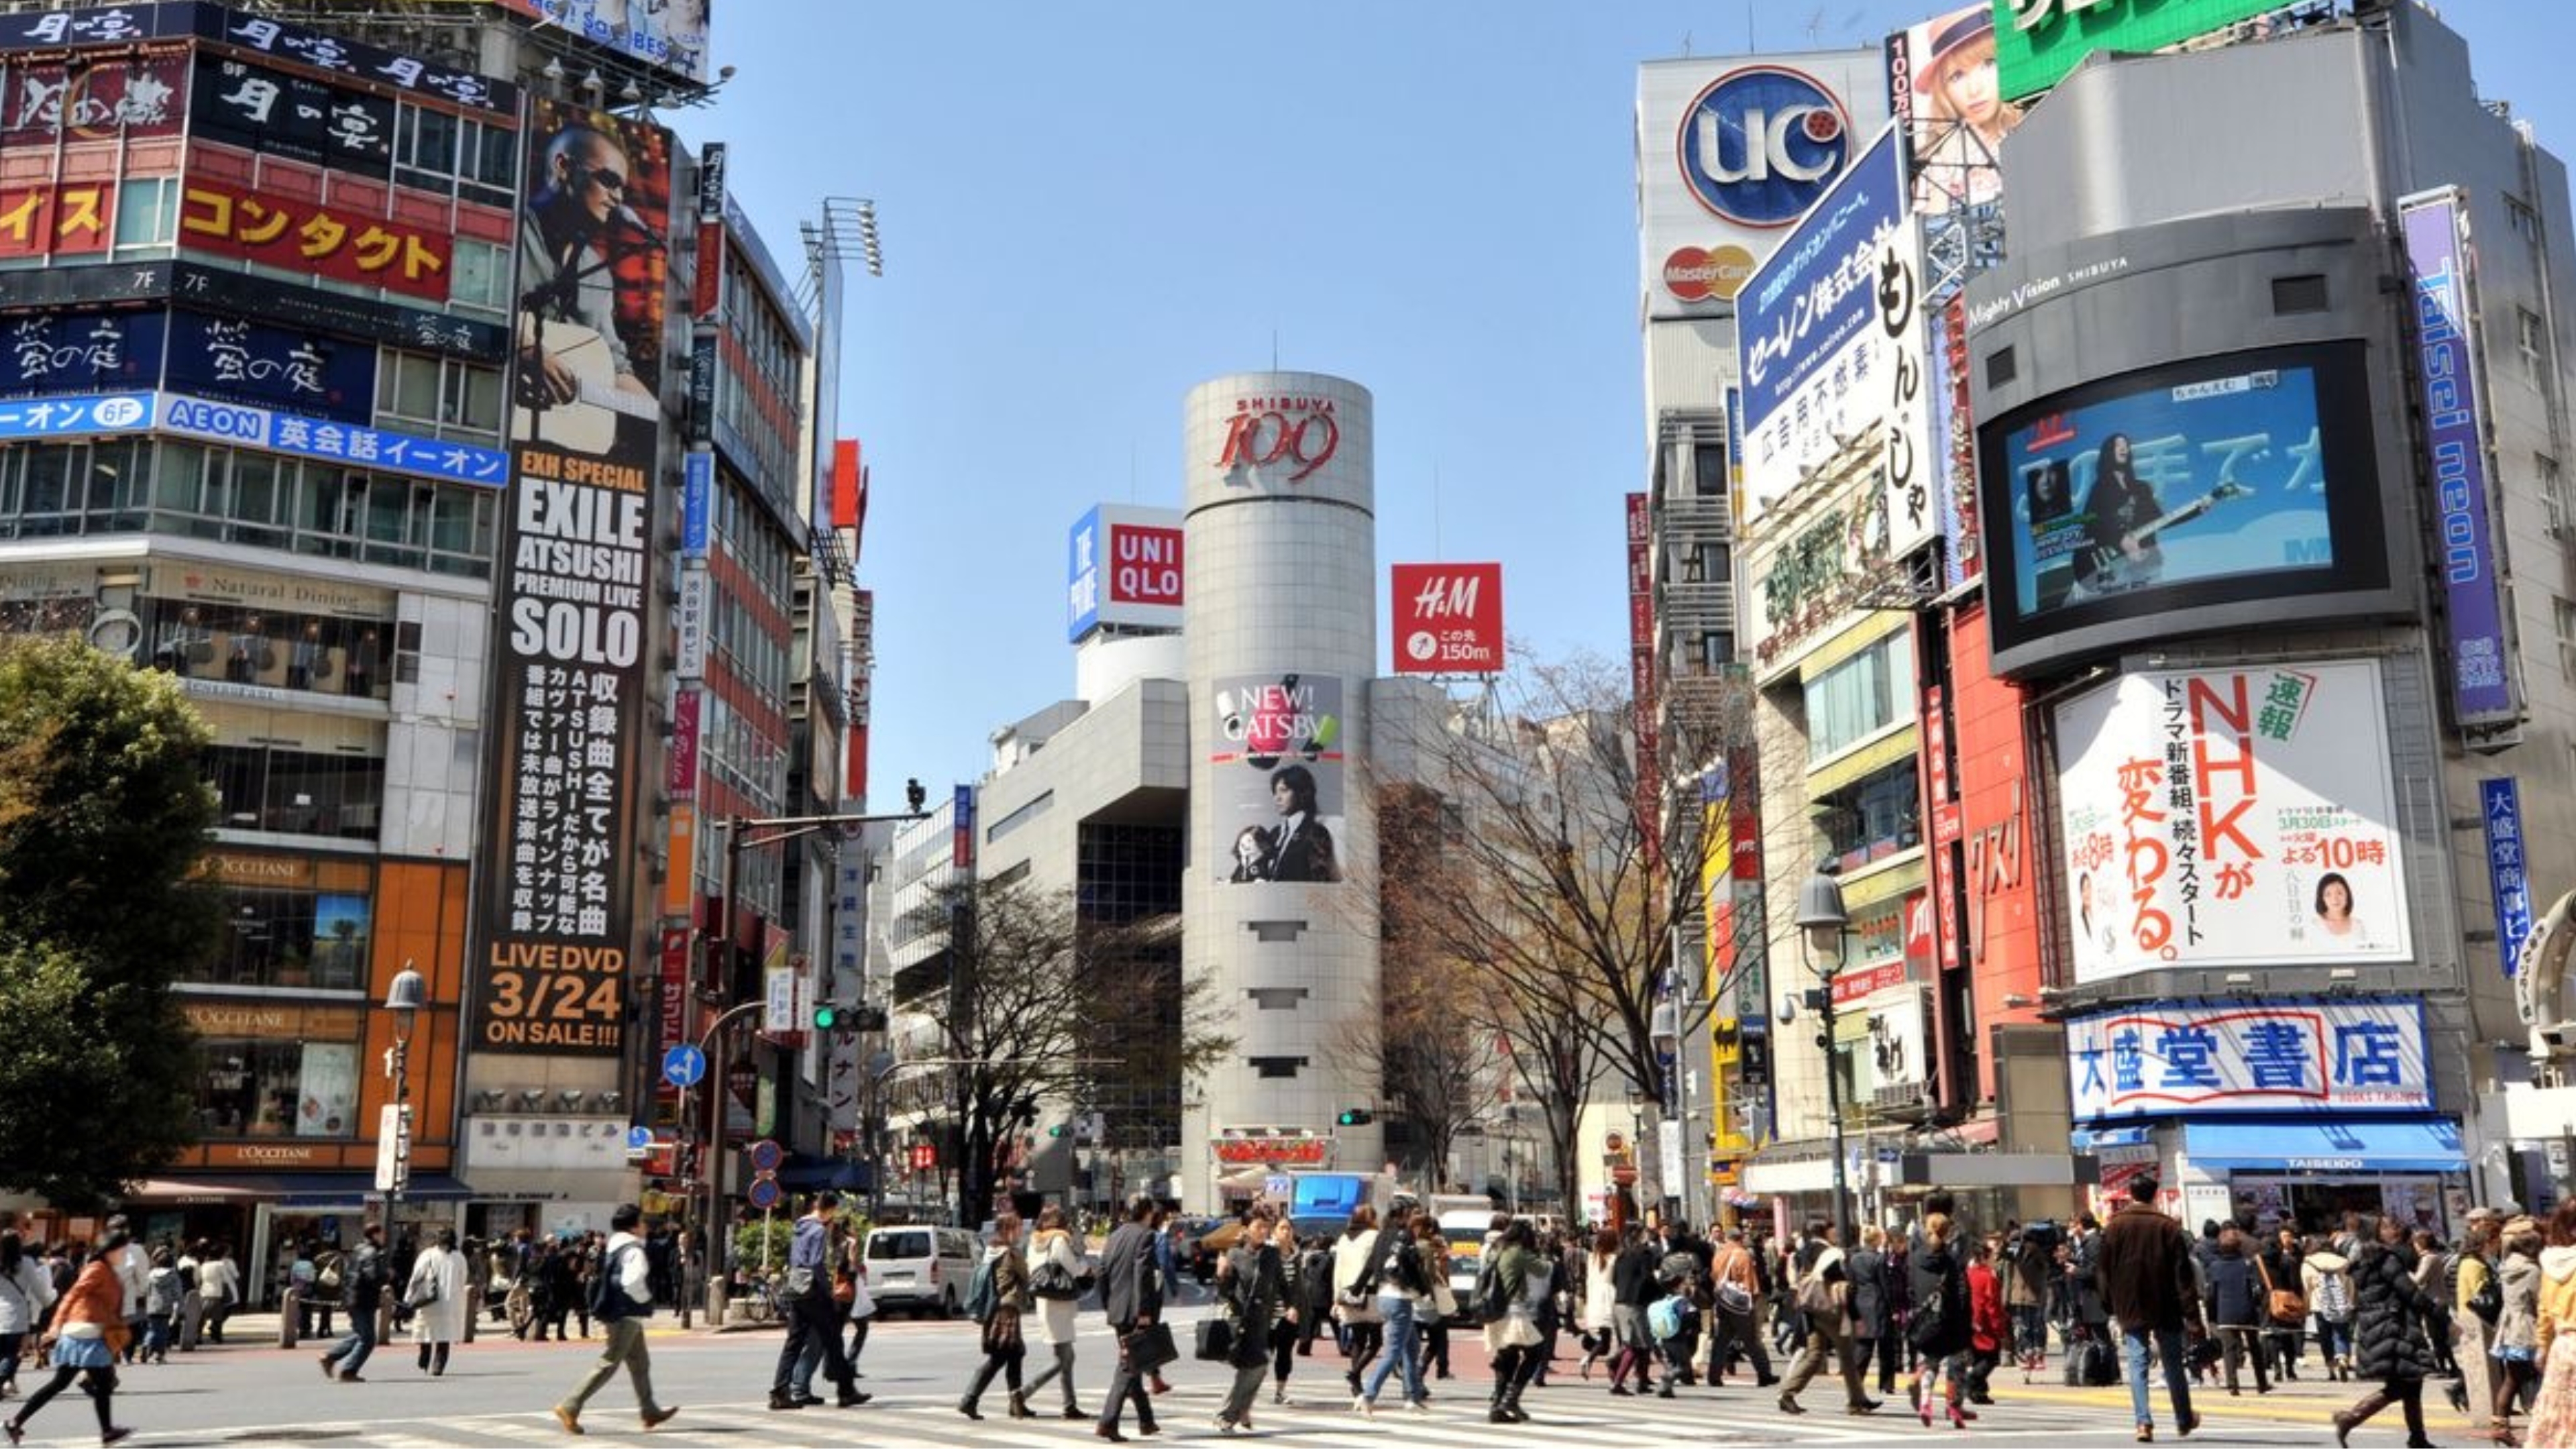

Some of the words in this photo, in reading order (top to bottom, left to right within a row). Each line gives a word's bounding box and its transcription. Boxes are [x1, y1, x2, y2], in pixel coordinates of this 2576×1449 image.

[184, 189, 441, 280] コンタクト
[134, 272, 157, 289] 7F
[185, 274, 209, 291] 7F
[1968, 296, 2010, 328] Mighty
[2012, 274, 2060, 309] Vision
[2067, 256, 2128, 283] SHIBUYA
[2418, 258, 2469, 429] Taisei
[1237, 397, 1335, 413] SHIBUYA
[1762, 337, 1880, 464] 広告用不燃素
[1878, 246, 1927, 529] もんじゃ
[104, 402, 133, 422] 6F
[168, 399, 262, 439] AEON
[277, 417, 502, 479] 英会話イーオン
[1214, 411, 1340, 481] 109
[521, 450, 559, 478] EXH
[564, 457, 647, 492] SPECIAL
[517, 477, 647, 549] EXILE
[2435, 440, 2479, 583] neon
[515, 535, 643, 585] ATSUSHI
[1120, 535, 1174, 564] UNI
[213, 577, 285, 600] Natural
[295, 584, 361, 606] Dining
[513, 572, 600, 603] PREMIUM
[604, 584, 641, 609] LIVE
[1120, 567, 1179, 598] QLO
[1414, 576, 1479, 620] H&M
[511, 596, 640, 667] SOLO
[1440, 629, 1477, 643] この先
[1440, 644, 1489, 661] 150m
[1241, 686, 1313, 710] NEW!
[2258, 673, 2304, 741] 速報
[1223, 713, 1327, 743] GATSBY
[511, 665, 546, 932] 番組では未放送楽曲を収録
[536, 667, 569, 934] カヴァー曲がラインナップ
[556, 669, 588, 936] ATSUSHIだから可能な
[577, 672, 619, 936] 収録曲全てが名曲
[2187, 675, 2265, 899] NHKが
[2162, 678, 2204, 947] ドラマ新番組、続々スタート
[2282, 837, 2385, 869] よる10時
[490, 942, 557, 969] LIVE
[561, 947, 624, 973] DVD
[488, 972, 621, 1020] 3/24
[486, 1020, 526, 1044] ON
[528, 1022, 620, 1047] SALE!!!
[2079, 1020, 2401, 1096] 大盛堂書店
[2287, 1159, 2363, 1169] TAISEIDO
